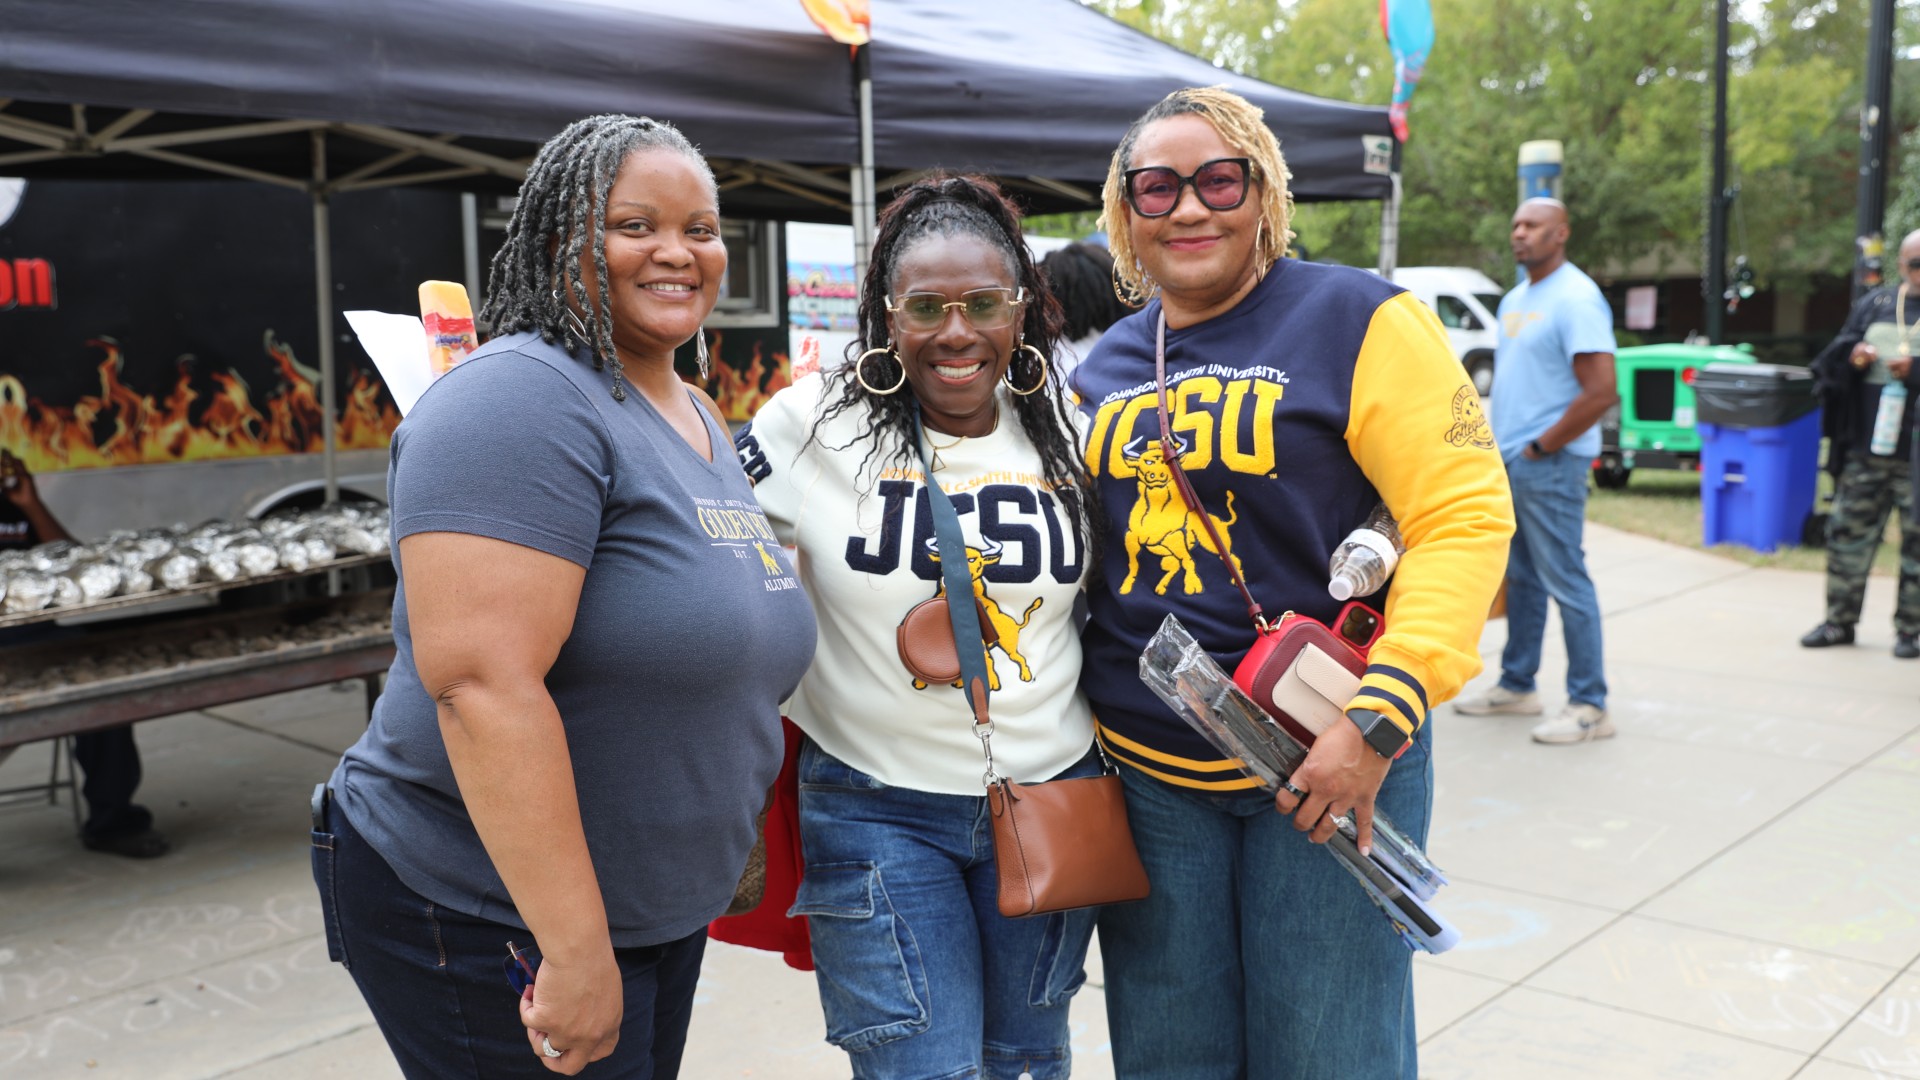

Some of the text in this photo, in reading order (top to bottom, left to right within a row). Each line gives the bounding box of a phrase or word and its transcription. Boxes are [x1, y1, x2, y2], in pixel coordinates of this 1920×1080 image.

[1207, 363, 1286, 384] UNIVERSITY
[697, 506, 760, 539] GOLDEN
[845, 480, 1085, 585] JCSU
[764, 577, 799, 592] ALUMNI
